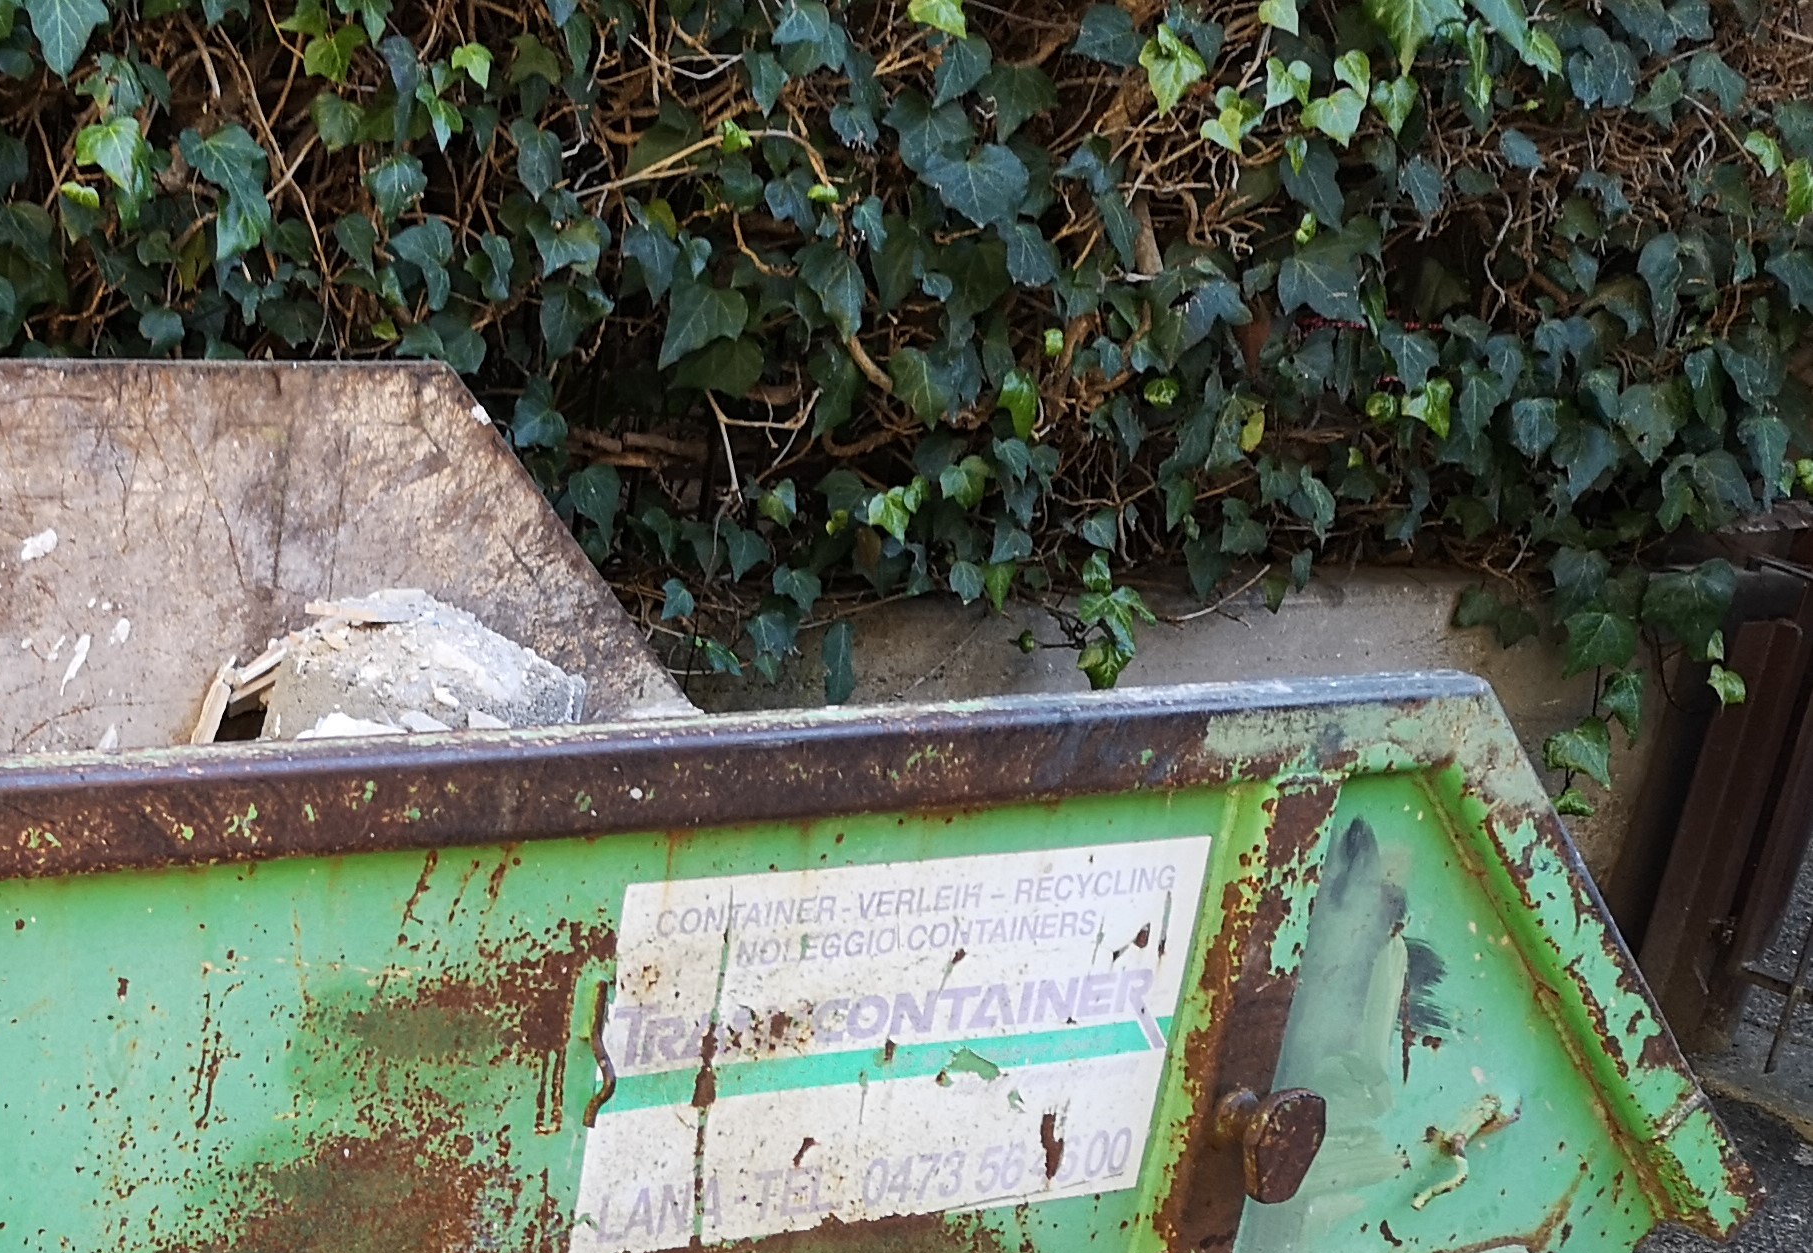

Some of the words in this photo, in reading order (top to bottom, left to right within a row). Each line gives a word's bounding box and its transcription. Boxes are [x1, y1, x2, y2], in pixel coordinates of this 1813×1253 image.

[1015, 865, 1177, 904] RECYCLING
[736, 928, 900, 968] NOLEGGIO
[908, 909, 1097, 951] CONTAINERS
[597, 1175, 723, 1243] LANA
[862, 1151, 966, 1206] 0473
